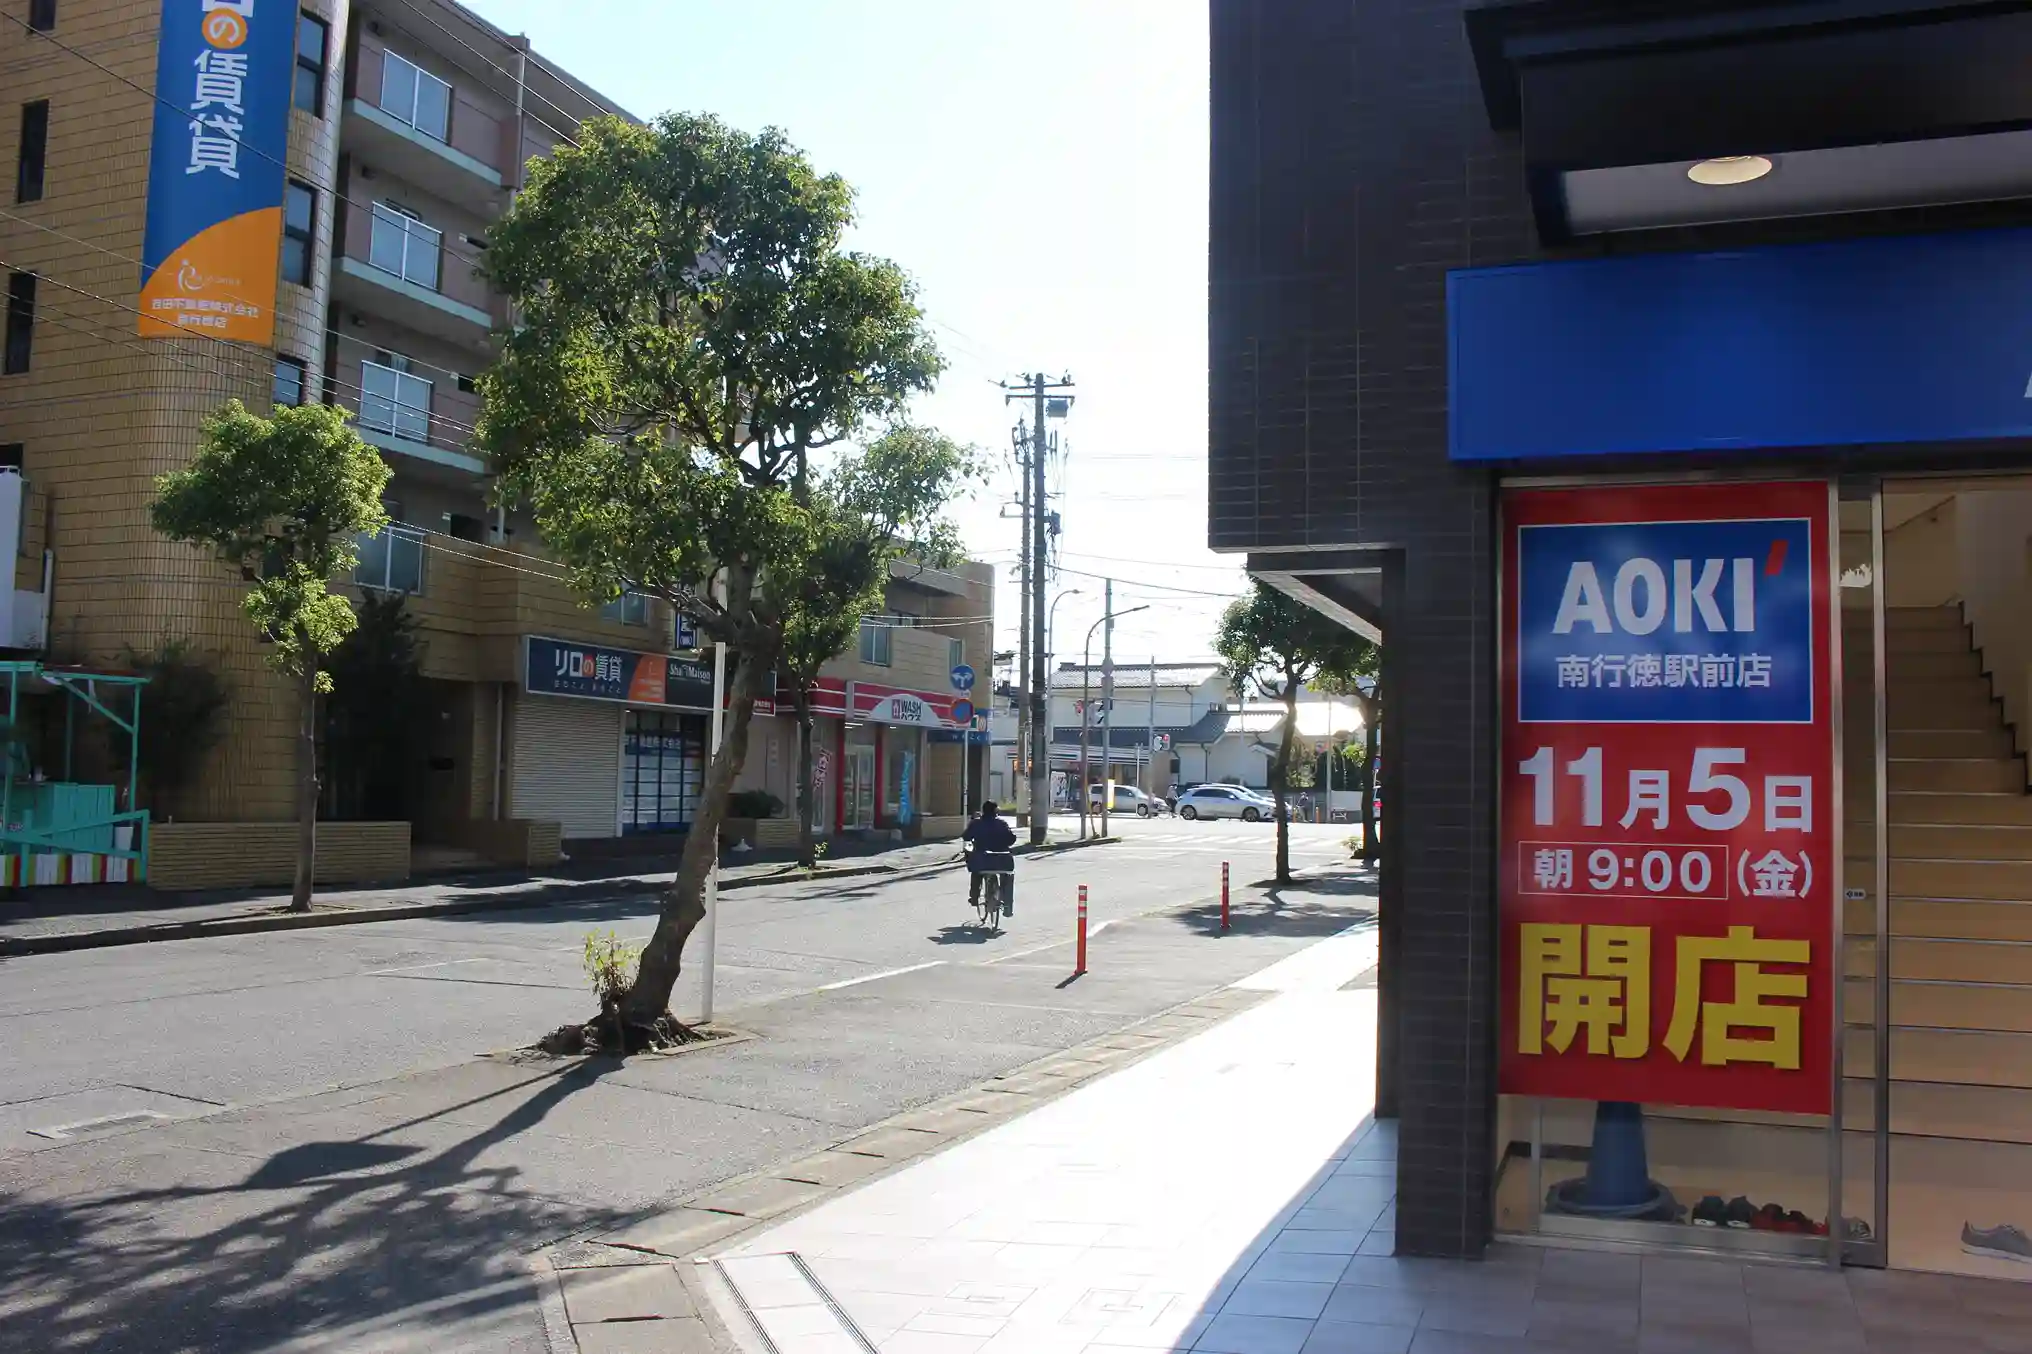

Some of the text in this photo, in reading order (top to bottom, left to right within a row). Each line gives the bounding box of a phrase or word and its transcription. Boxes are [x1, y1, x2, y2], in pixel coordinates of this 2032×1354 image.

[554, 648, 623, 683] リロの賃貸
[1555, 652, 1772, 689] 南行徳駅前店
[901, 700, 922, 714] WASH
[1518, 747, 1813, 833] 11月5日
[1534, 848, 1814, 899] 朝 9:00 (金)
[1517, 922, 1812, 1071] 開店
